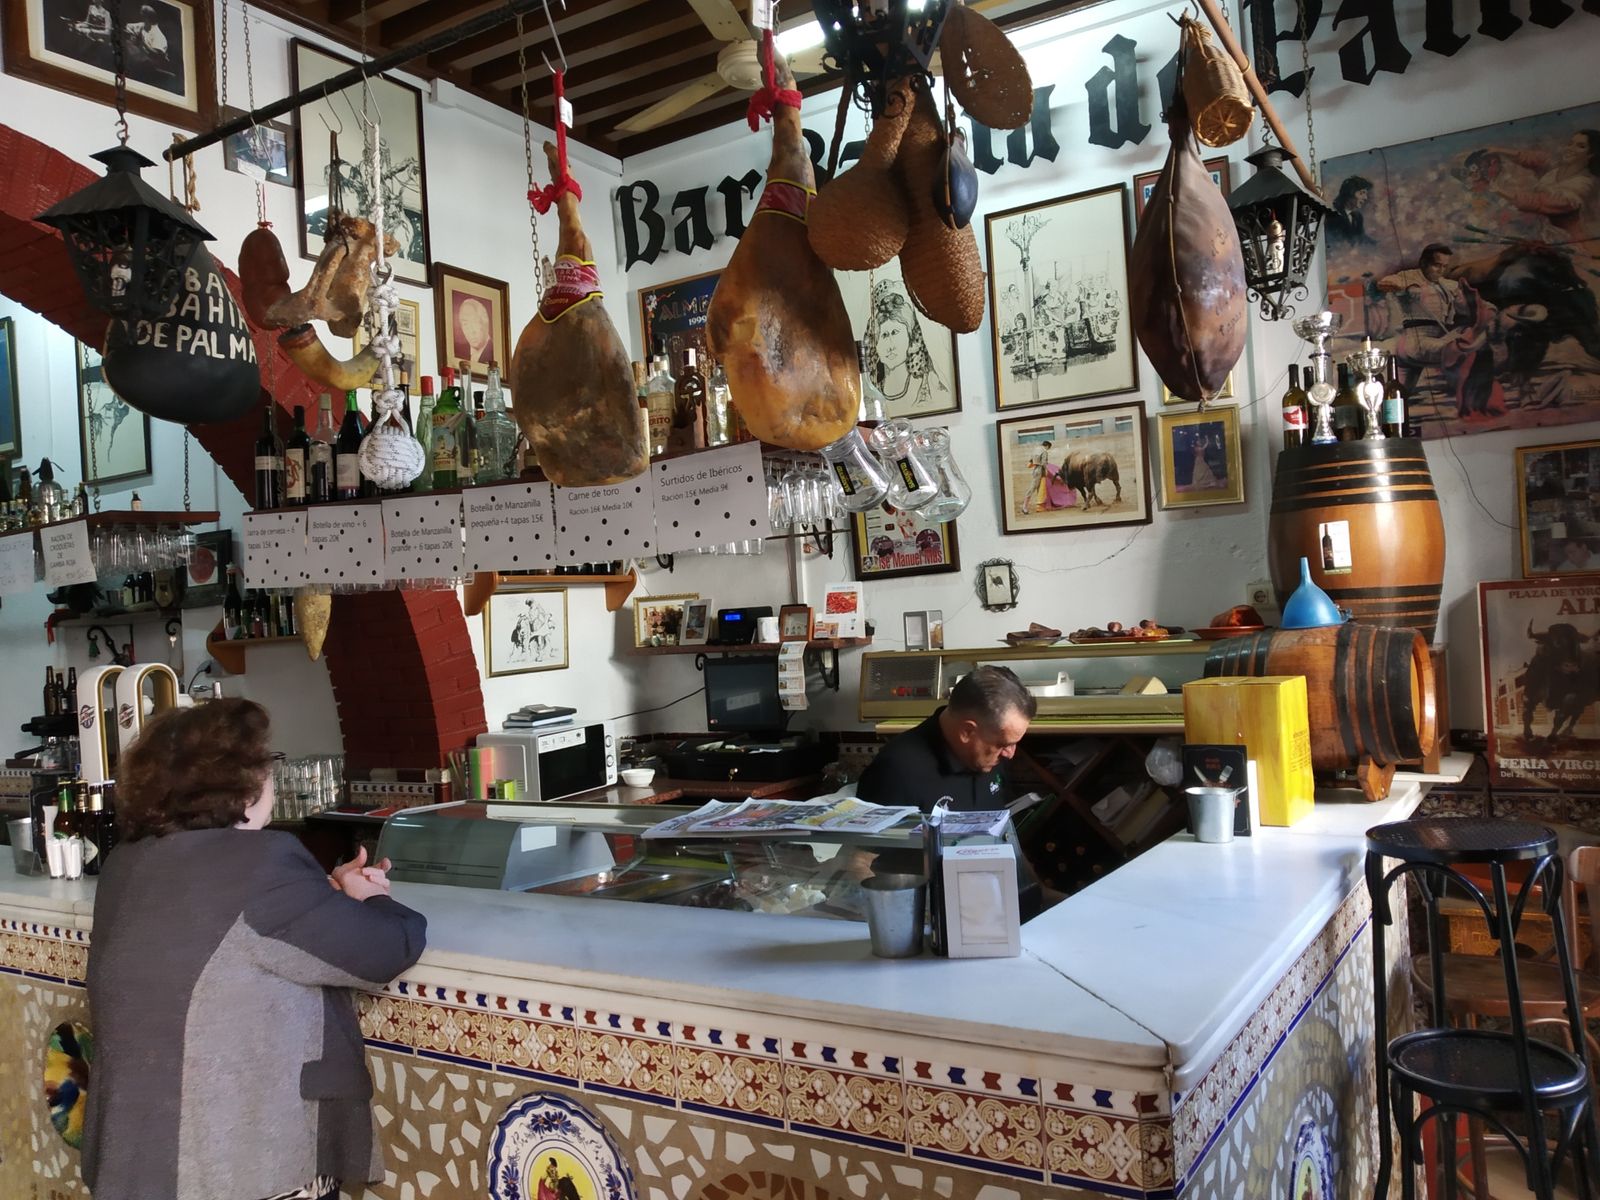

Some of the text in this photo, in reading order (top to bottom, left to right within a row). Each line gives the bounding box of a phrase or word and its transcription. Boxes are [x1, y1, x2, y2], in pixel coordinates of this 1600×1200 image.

[615, 169, 762, 273] Bar
[175, 324, 258, 365] PALMA
[660, 464, 743, 487] Surtidos de Ibéricos
[568, 487, 620, 502] Carne de toro
[685, 489, 697, 498] 15€
[698, 486, 719, 495] Media
[720, 483, 728, 491] 9€
[470, 498, 541, 513] Botella de Manzanilla
[602, 503, 621, 512] Media
[312, 521, 332, 529] Botella
[342, 520, 355, 528] vino
[362, 519, 367, 528] 6
[510, 517, 530, 527] tapas
[531, 513, 544, 523] 15€
[390, 526, 452, 538] Botella de Manzanilla
[312, 535, 328, 544] tapas
[390, 544, 411, 554] grande
[418, 542, 424, 550] 6
[424, 543, 441, 552] tapas
[442, 540, 454, 550] 20€
[1509, 589, 1548, 599] PLAZA
[1551, 588, 1567, 597] DE
[1499, 758, 1549, 769] FERIA
[1537, 771, 1547, 779] 30
